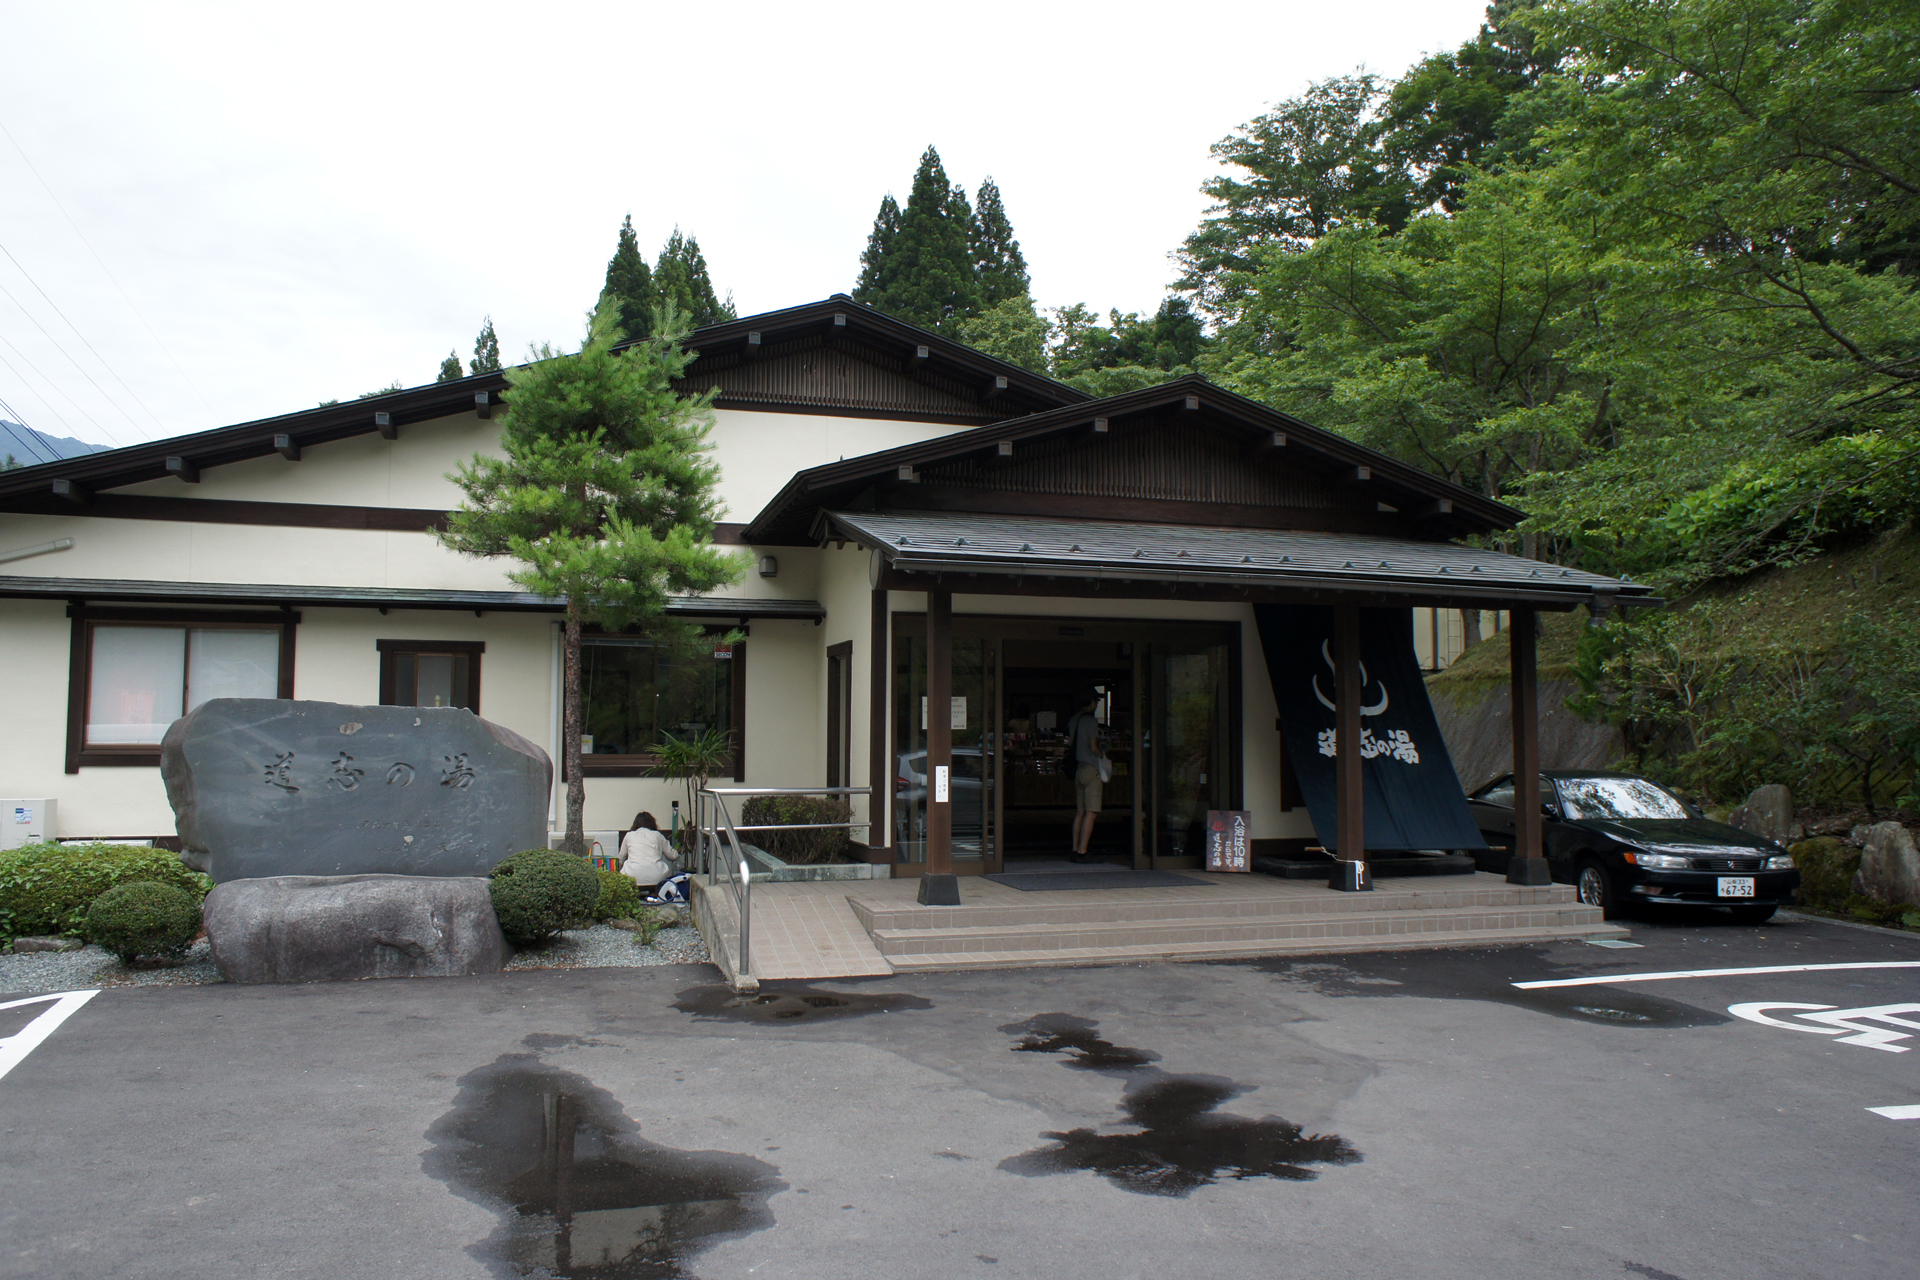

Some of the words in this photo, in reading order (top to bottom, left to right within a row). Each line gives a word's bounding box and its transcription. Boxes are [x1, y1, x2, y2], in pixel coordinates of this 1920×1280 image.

[264, 751, 476, 793] 道志の湯
[1234, 816, 1245, 868] 入浴は10時
[1726, 886, 1752, 895] 67-52
